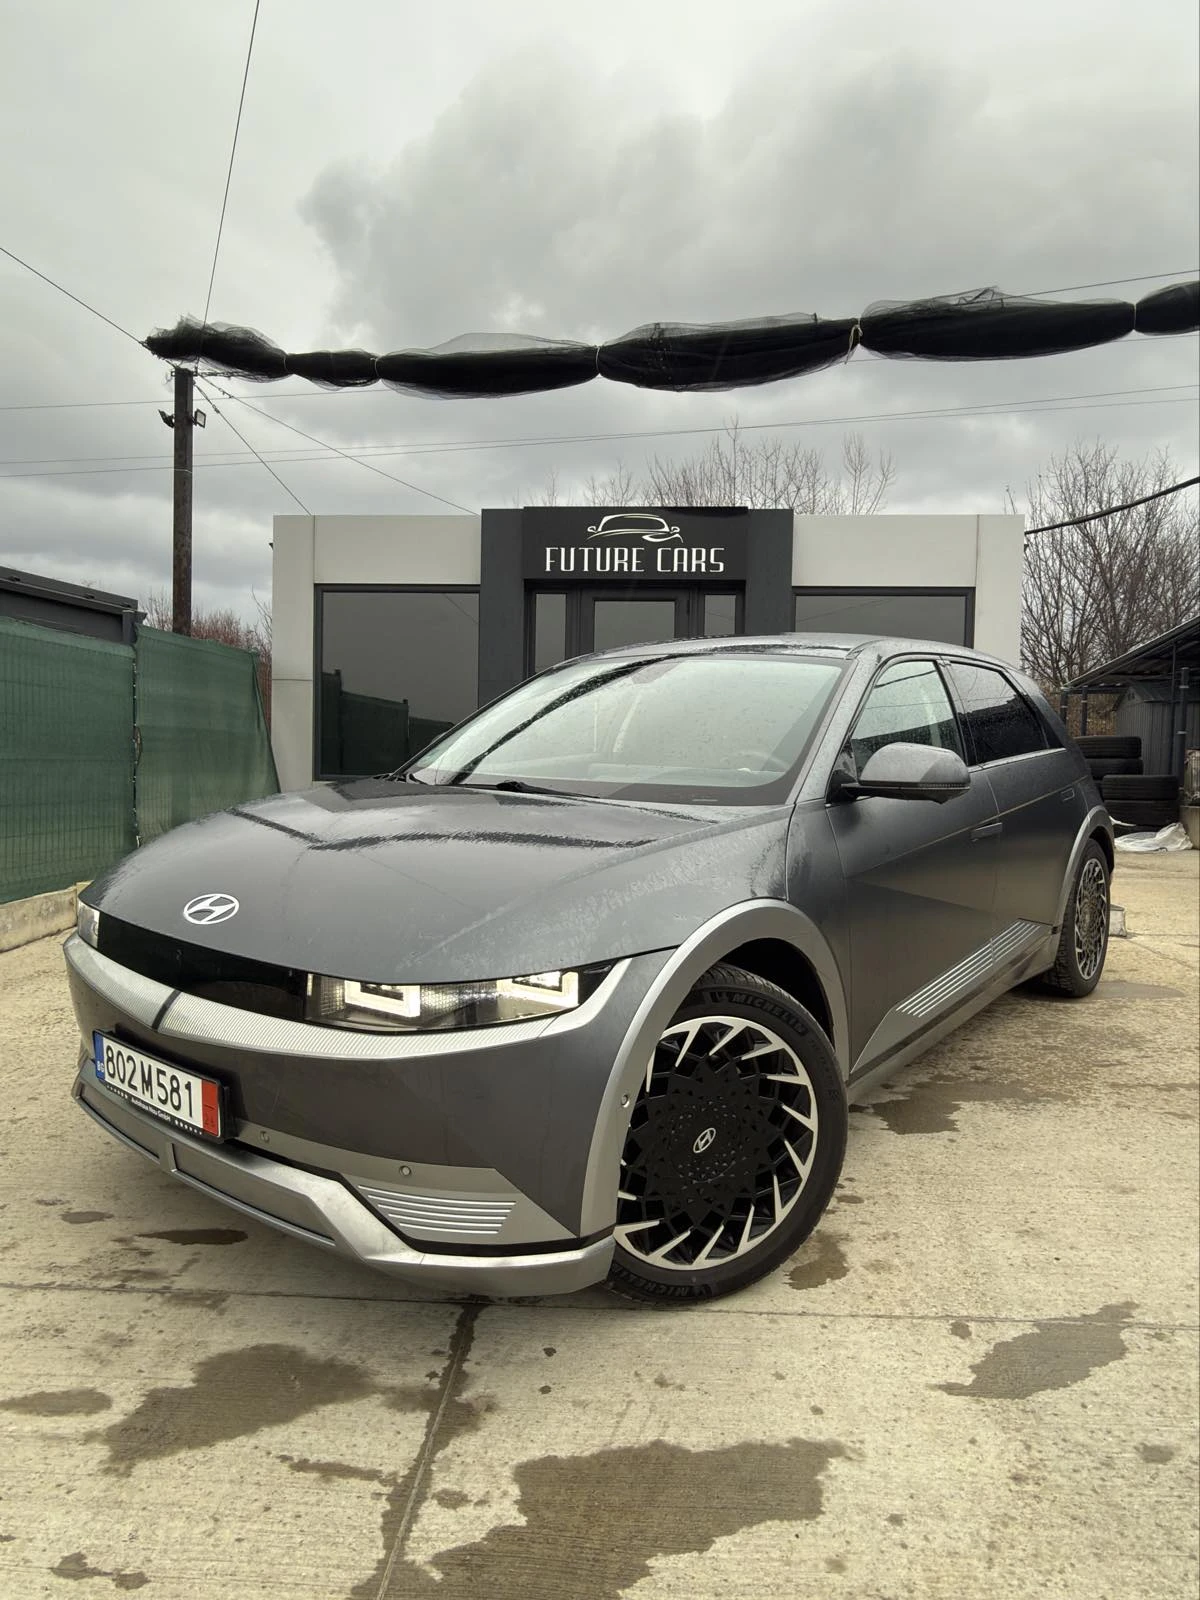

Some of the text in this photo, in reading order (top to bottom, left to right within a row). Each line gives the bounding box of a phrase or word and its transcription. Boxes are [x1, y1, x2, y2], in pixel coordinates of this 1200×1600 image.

[545, 547, 725, 573] FUTURE CARS
[732, 993, 808, 1036] MICHELIN
[105, 1045, 193, 1118] 802M581
